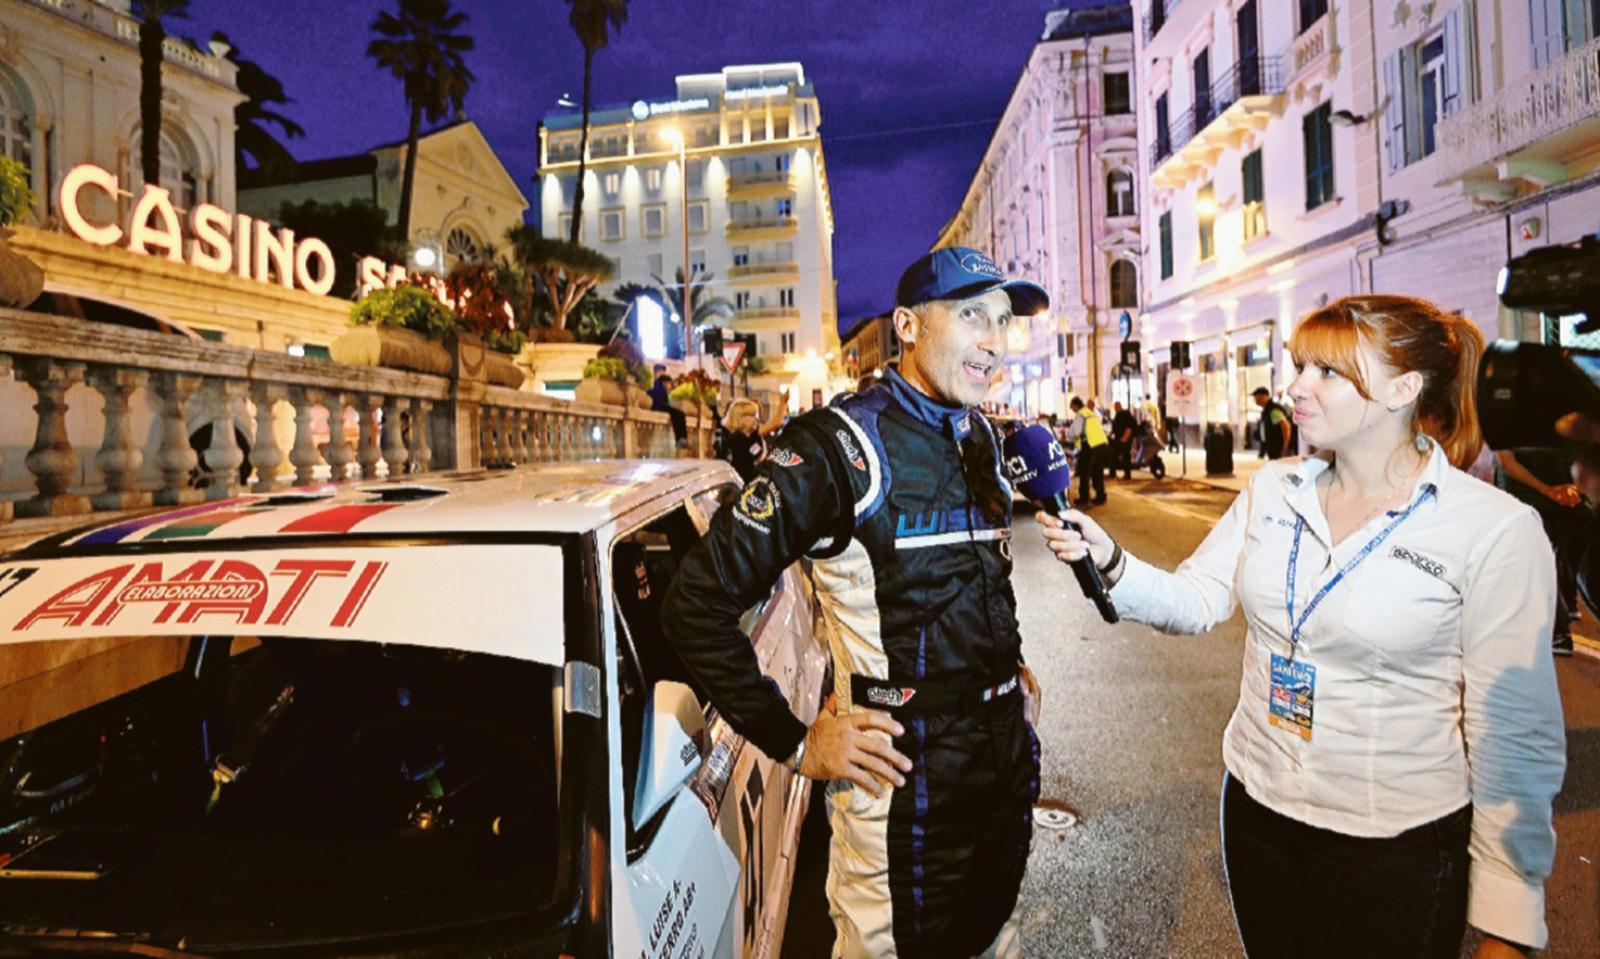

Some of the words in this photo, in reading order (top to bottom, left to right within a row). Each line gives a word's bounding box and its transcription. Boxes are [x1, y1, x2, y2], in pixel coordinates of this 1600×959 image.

[60, 163, 336, 296] CASINO
[12, 559, 389, 631] AMATI
[125, 581, 258, 602] ELABORAZIONI
[649, 891, 673, 952] LUISE
